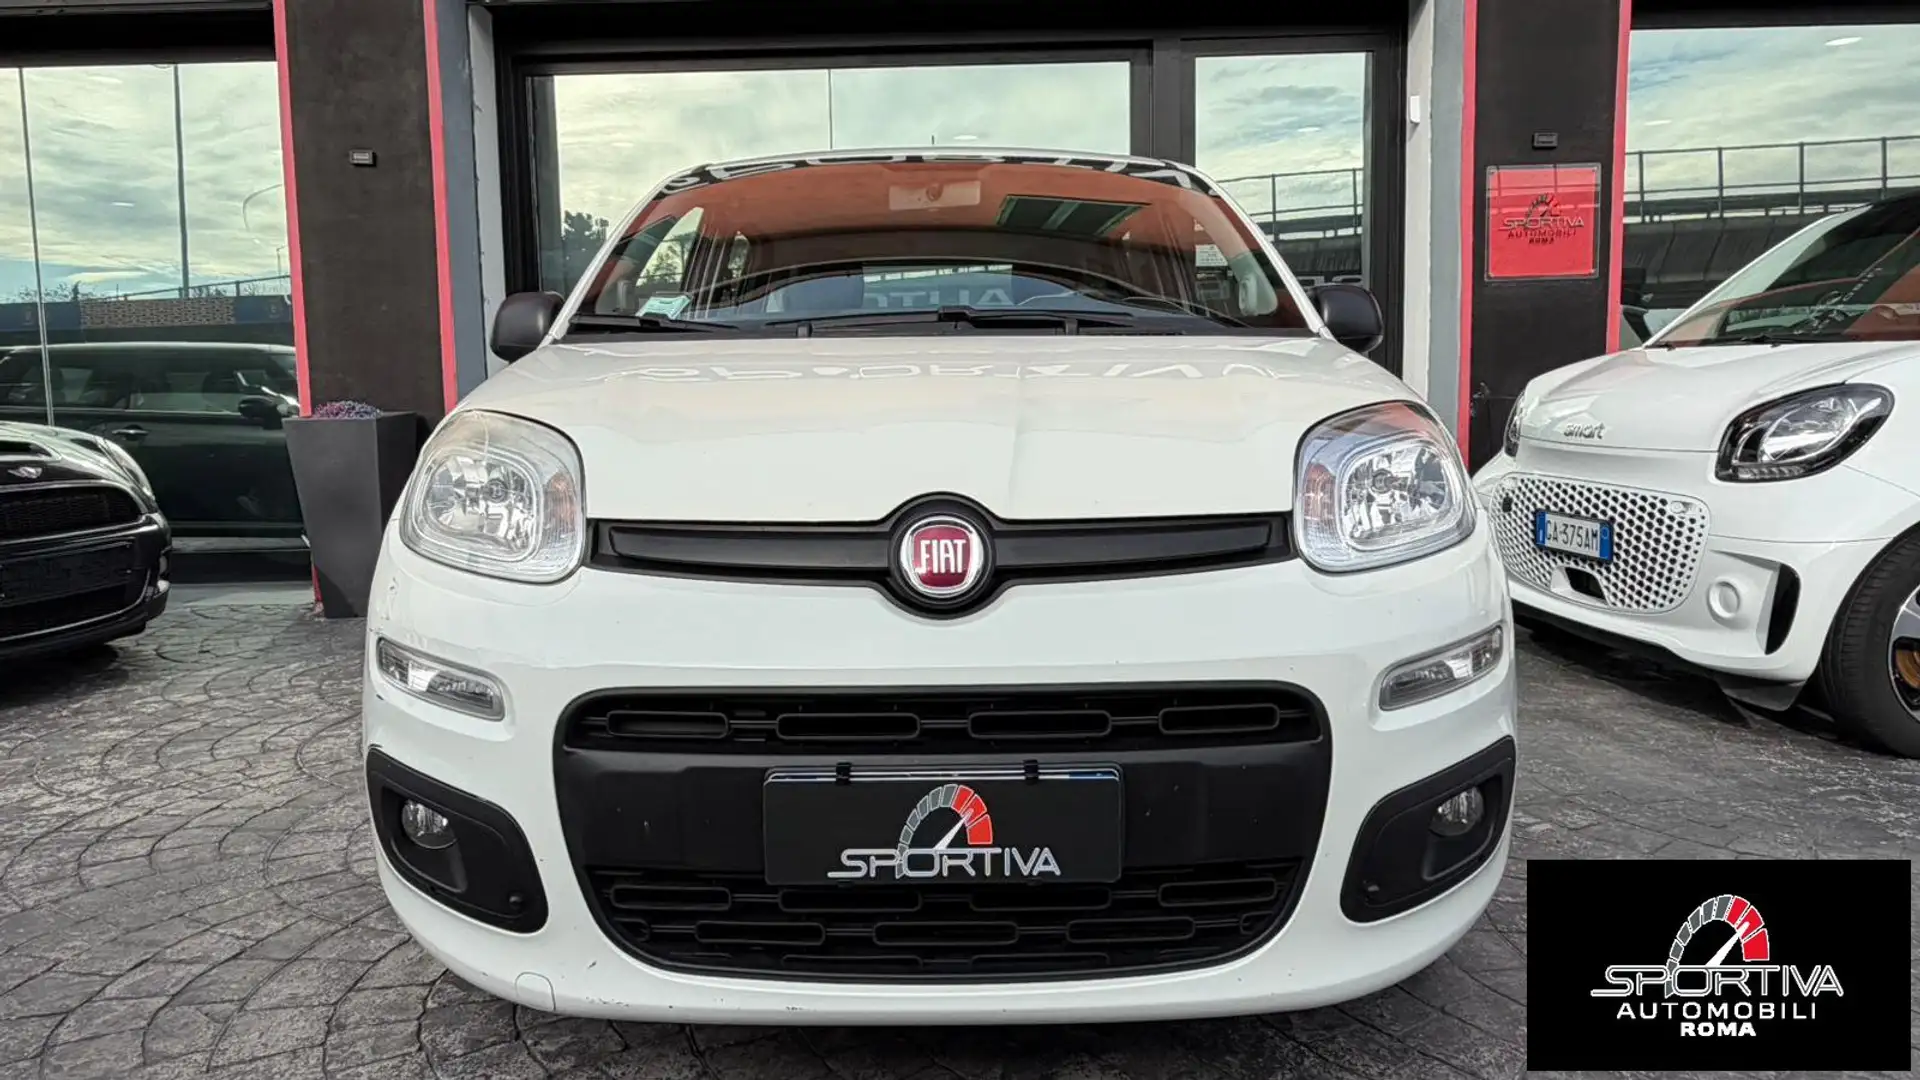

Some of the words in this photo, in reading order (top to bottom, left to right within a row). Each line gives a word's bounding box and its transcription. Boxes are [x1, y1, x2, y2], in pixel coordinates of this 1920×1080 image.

[1499, 216, 1584, 230] SPORTIVA
[1563, 423, 1605, 440] smart
[914, 538, 967, 574] FIAT
[827, 847, 1062, 878] SPORTIVA
